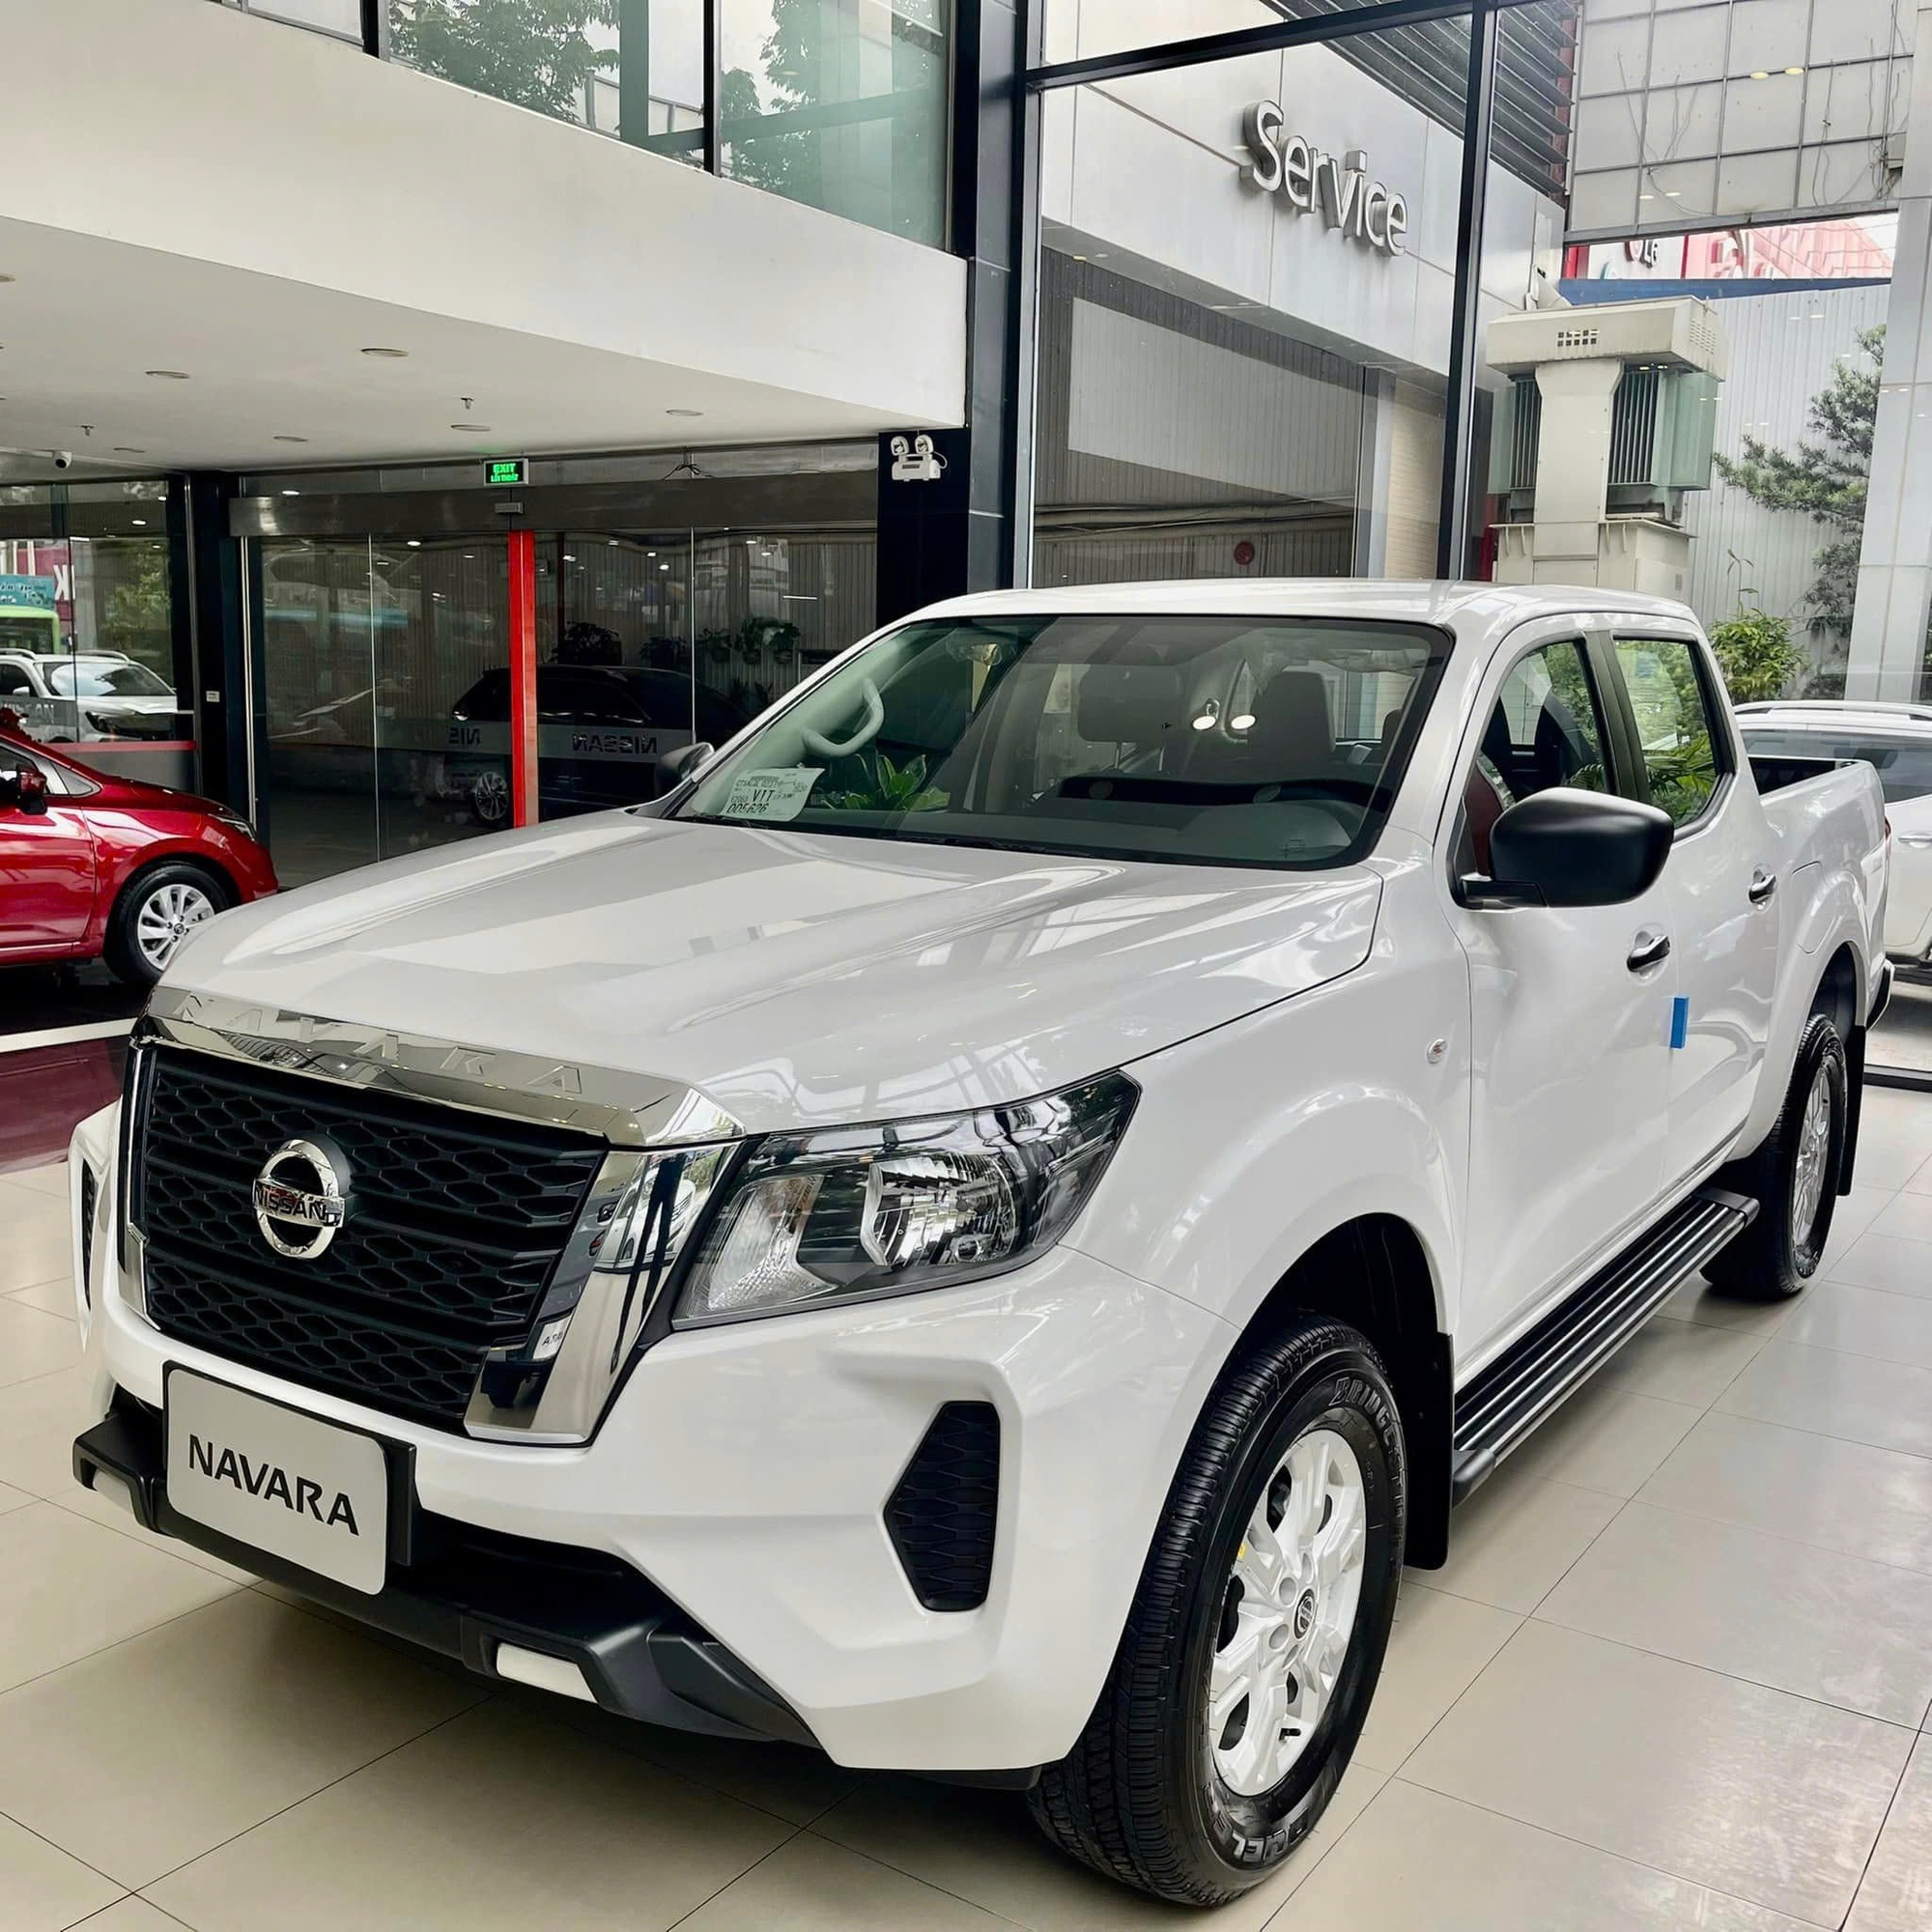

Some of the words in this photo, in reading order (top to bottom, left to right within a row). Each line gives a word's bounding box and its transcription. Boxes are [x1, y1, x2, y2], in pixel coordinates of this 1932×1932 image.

[1242, 99, 1407, 256] Service
[494, 463, 516, 473] EXIT
[174, 992, 582, 1094] NAVARA
[255, 1179, 327, 1222] NISSAN
[188, 1434, 359, 1536] NAVARA
